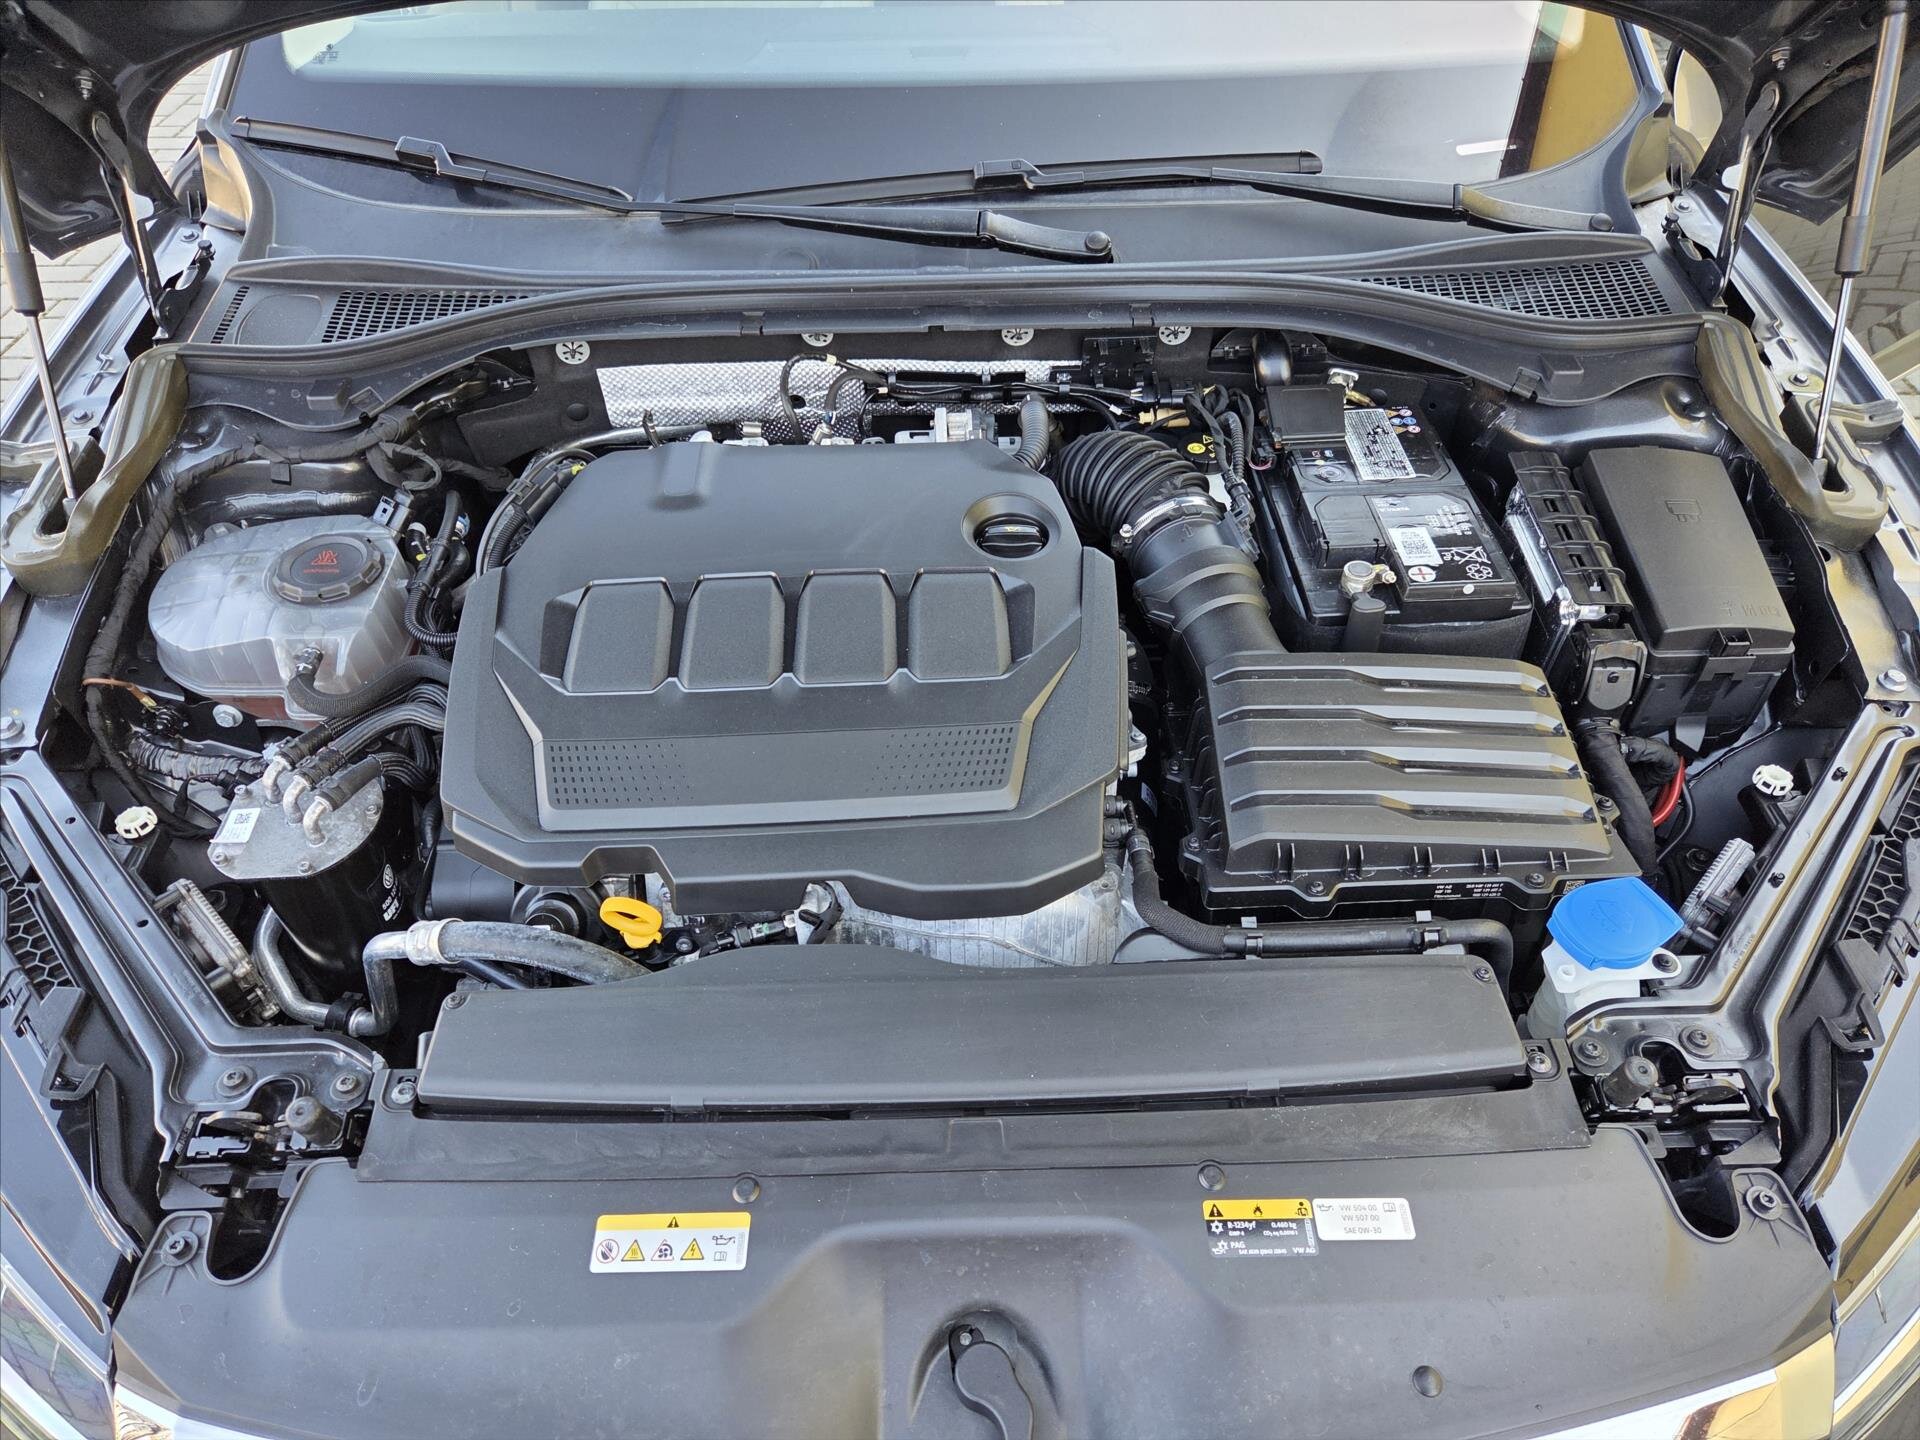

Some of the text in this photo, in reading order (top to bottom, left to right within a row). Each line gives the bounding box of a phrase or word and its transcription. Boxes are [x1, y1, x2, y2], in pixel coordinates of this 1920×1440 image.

[1227, 1221, 1256, 1231] R-1234yf
[1288, 1221, 1297, 1230] kg
[1230, 1241, 1246, 1249] PAG
